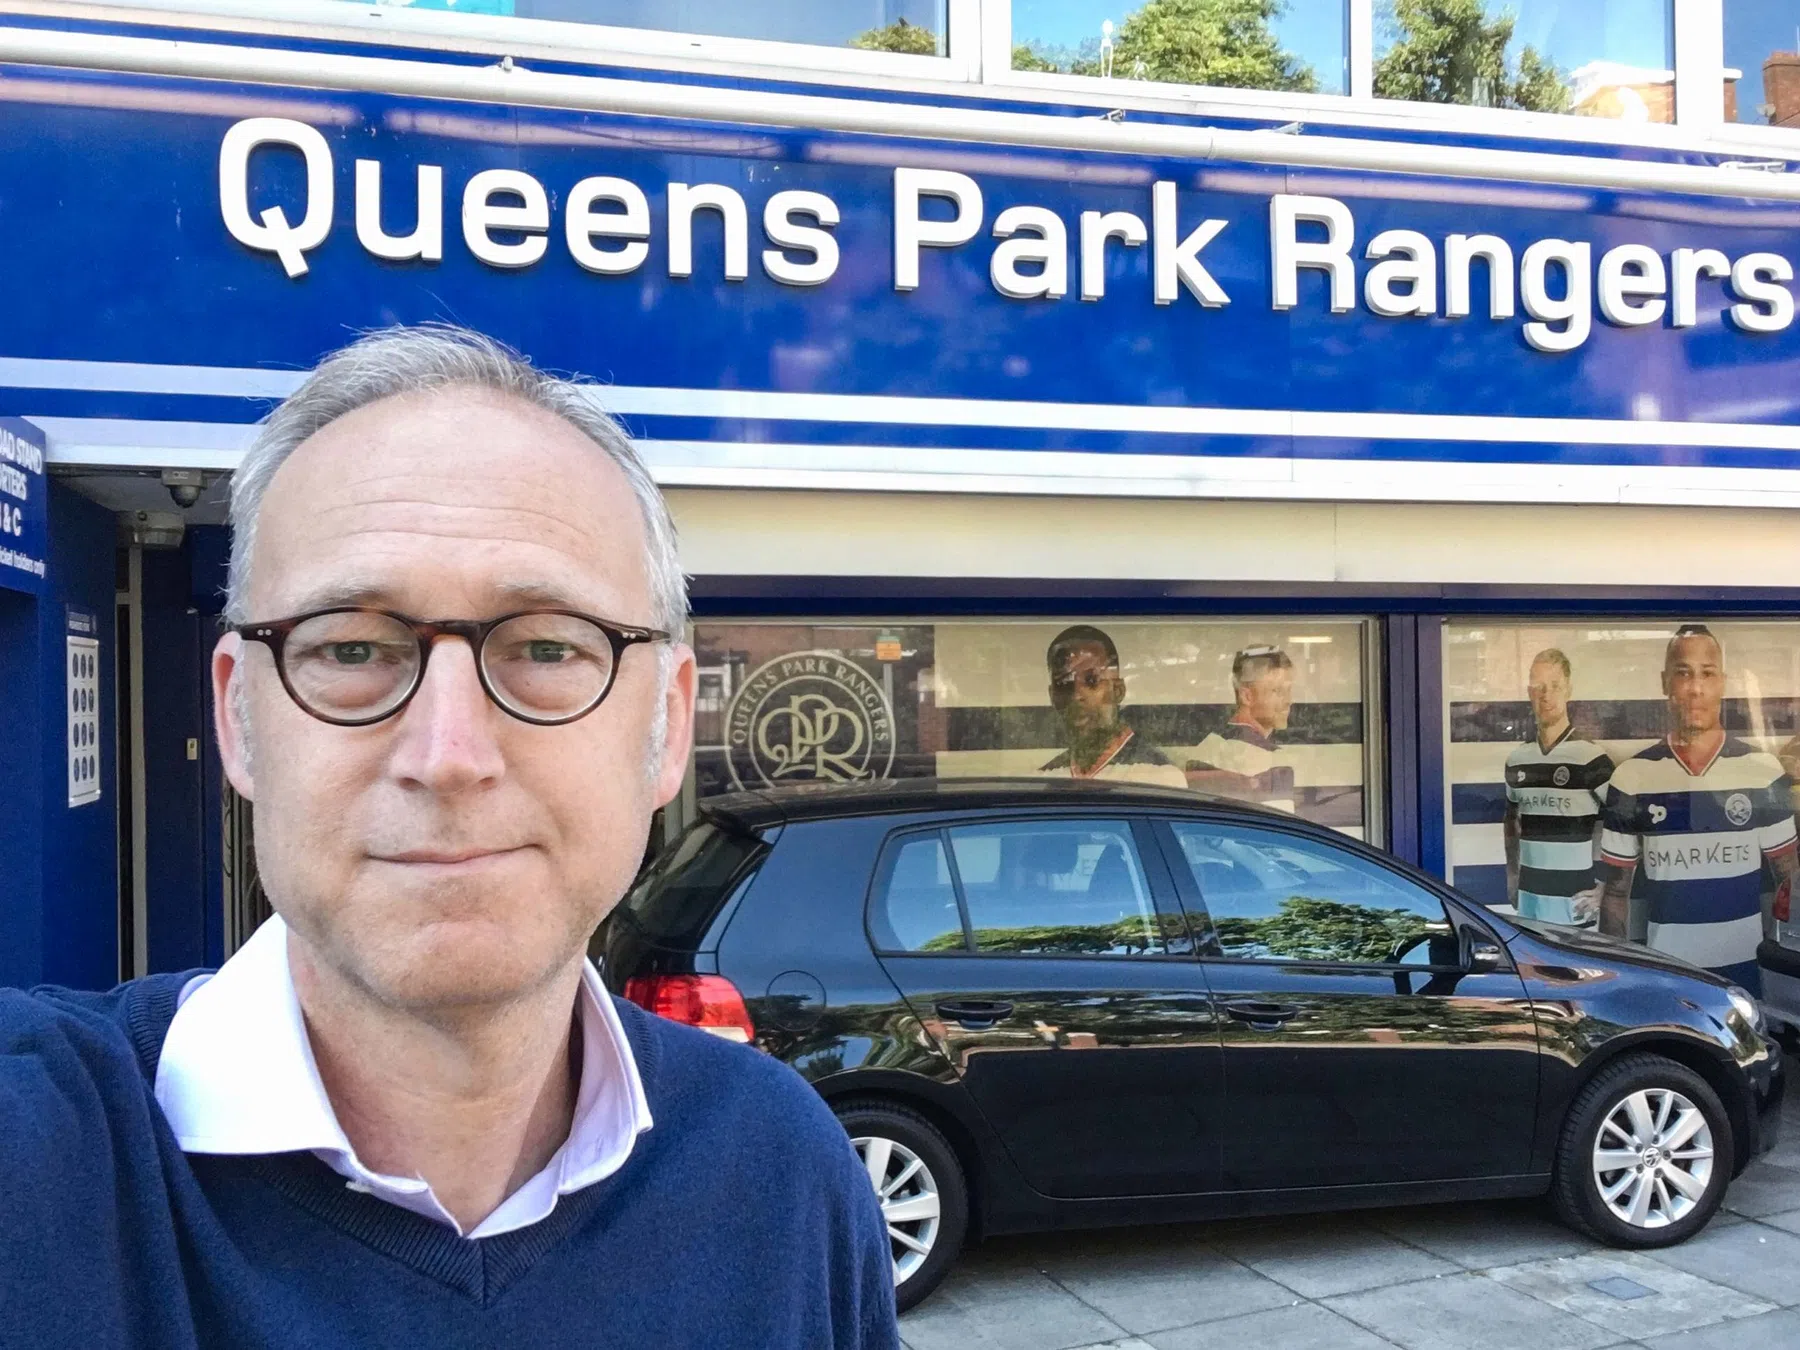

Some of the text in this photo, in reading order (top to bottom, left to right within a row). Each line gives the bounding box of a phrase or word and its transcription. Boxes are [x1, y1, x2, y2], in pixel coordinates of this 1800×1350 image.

[219, 117, 1795, 352] Queens Park Rangers
[732, 657, 889, 744] QUEENS PARK RANGERS
[1511, 793, 1572, 810] MARKETS
[1648, 842, 1750, 869] SMARKETS
